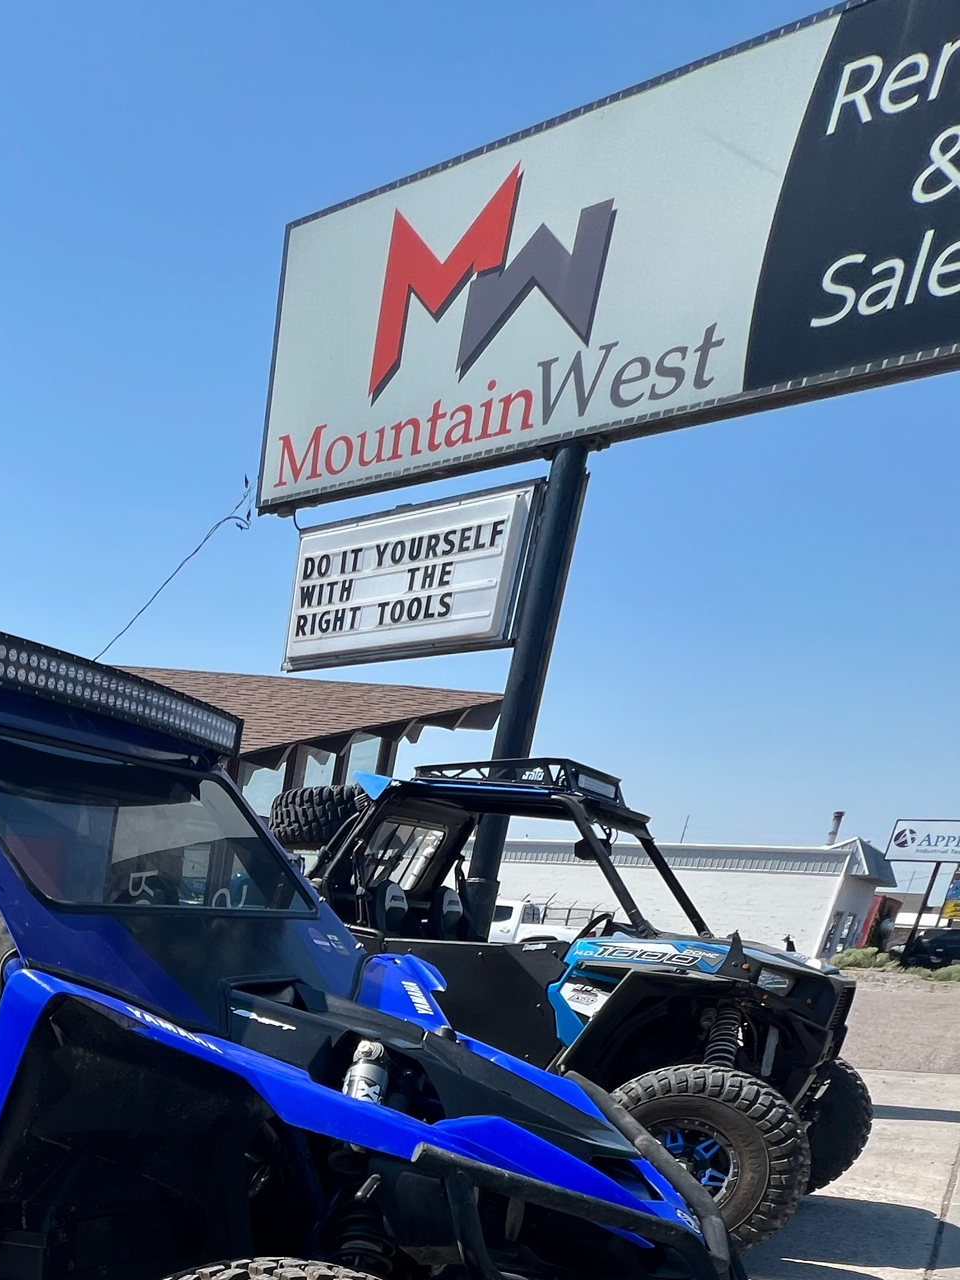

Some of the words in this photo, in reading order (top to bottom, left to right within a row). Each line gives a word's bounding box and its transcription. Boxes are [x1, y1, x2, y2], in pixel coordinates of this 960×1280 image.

[911, 124, 960, 205] &
[810, 229, 960, 327] Sale
[302, 554, 331, 580] DO
[339, 548, 364, 574] IT
[375, 521, 505, 568] YOURSELF
[300, 578, 354, 608] WITH
[407, 562, 454, 592] THE
[295, 606, 361, 637] RIGHT
[378, 592, 453, 625] TOOLS
[593, 945, 702, 966] 1000
[683, 948, 720, 959] DOHC
[401, 980, 435, 1016] YAMAHA
